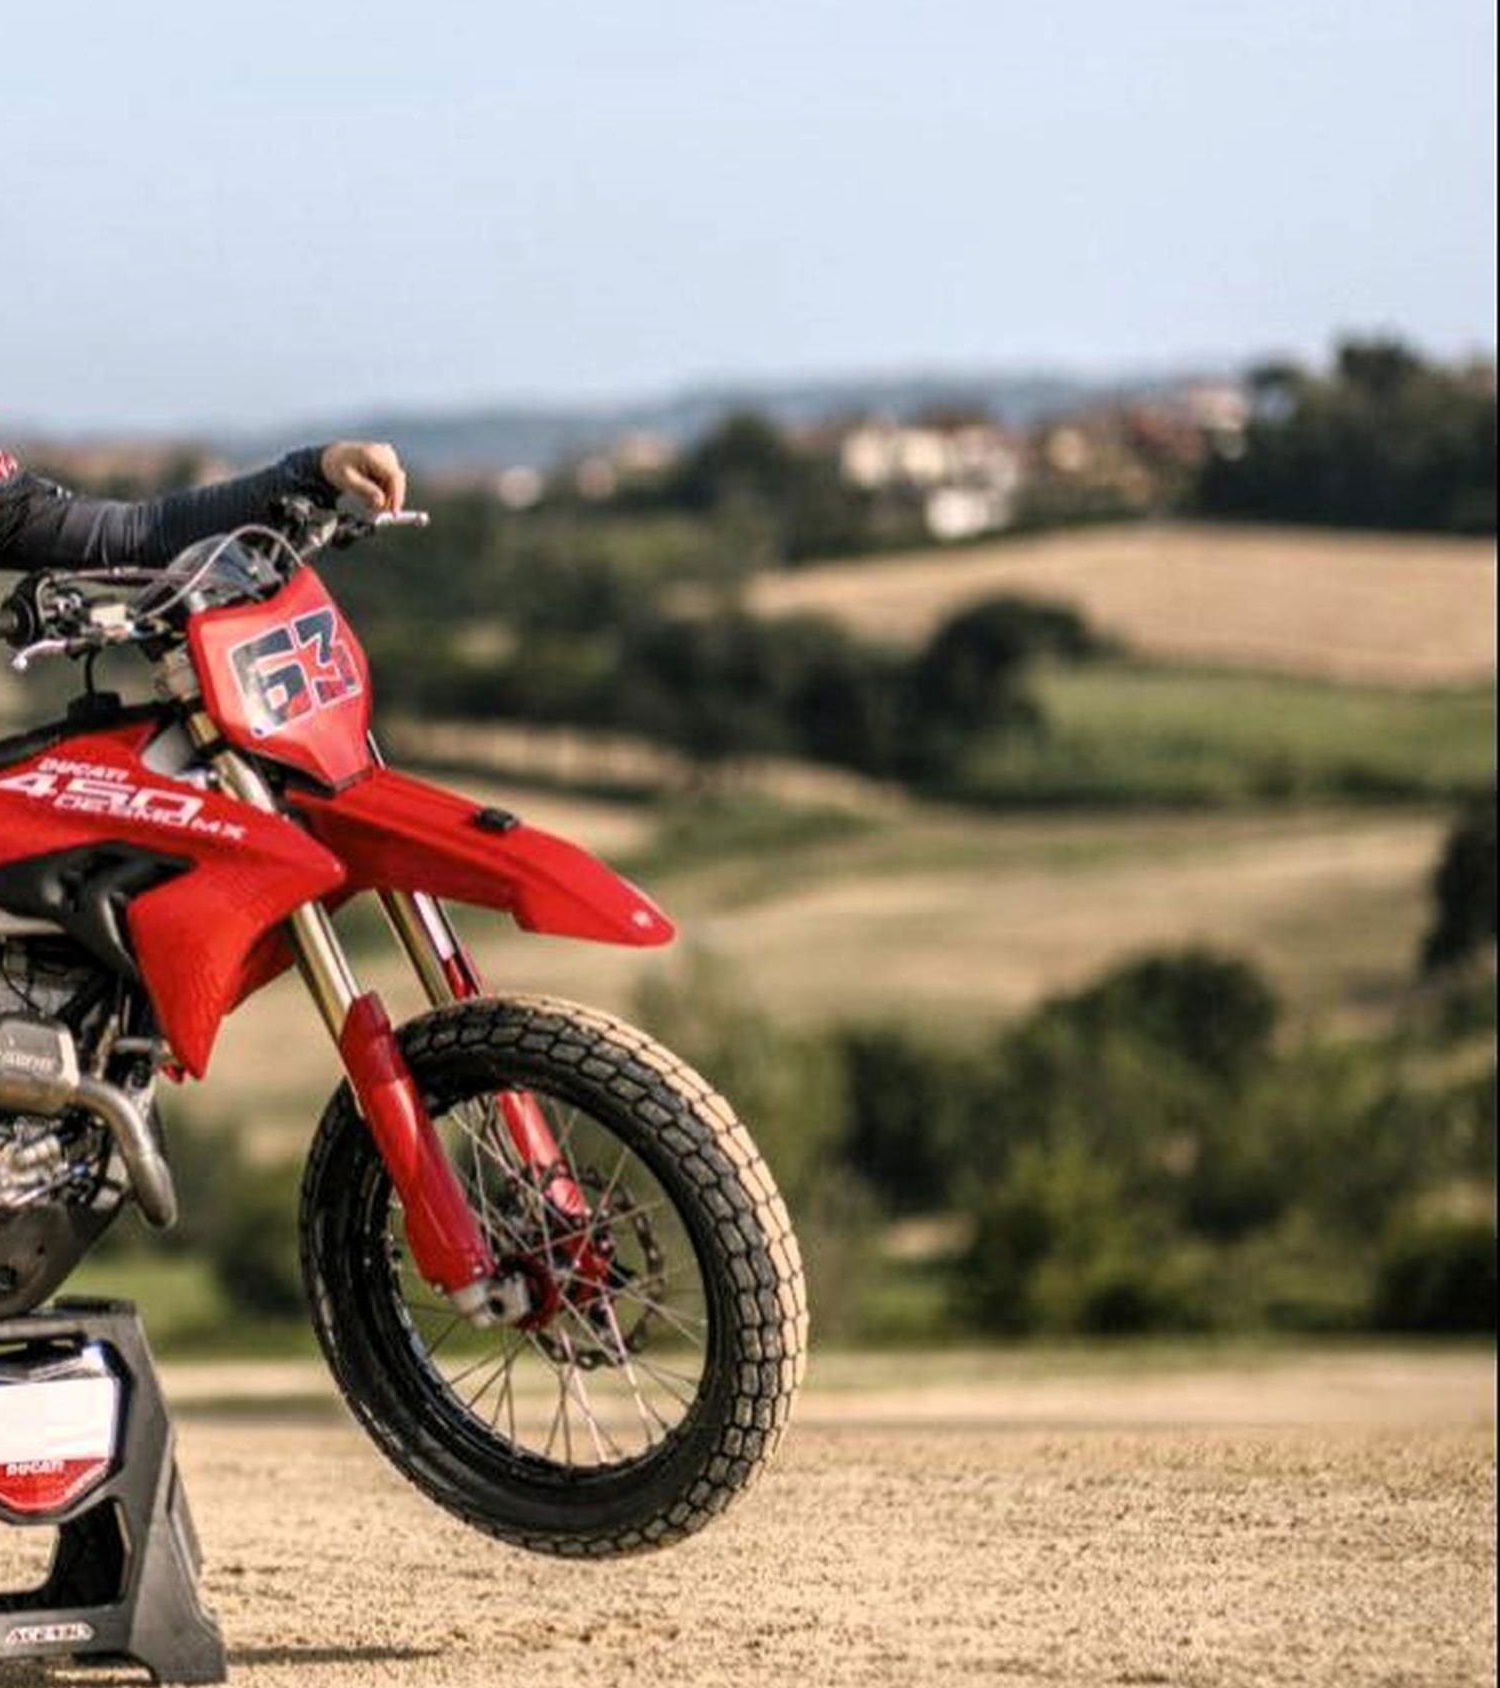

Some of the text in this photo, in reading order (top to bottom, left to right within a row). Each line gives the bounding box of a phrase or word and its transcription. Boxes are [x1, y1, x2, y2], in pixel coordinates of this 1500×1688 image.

[227, 606, 363, 739] 63
[37, 757, 129, 782] DUCATI
[6, 1459, 65, 1477] DUCATI
